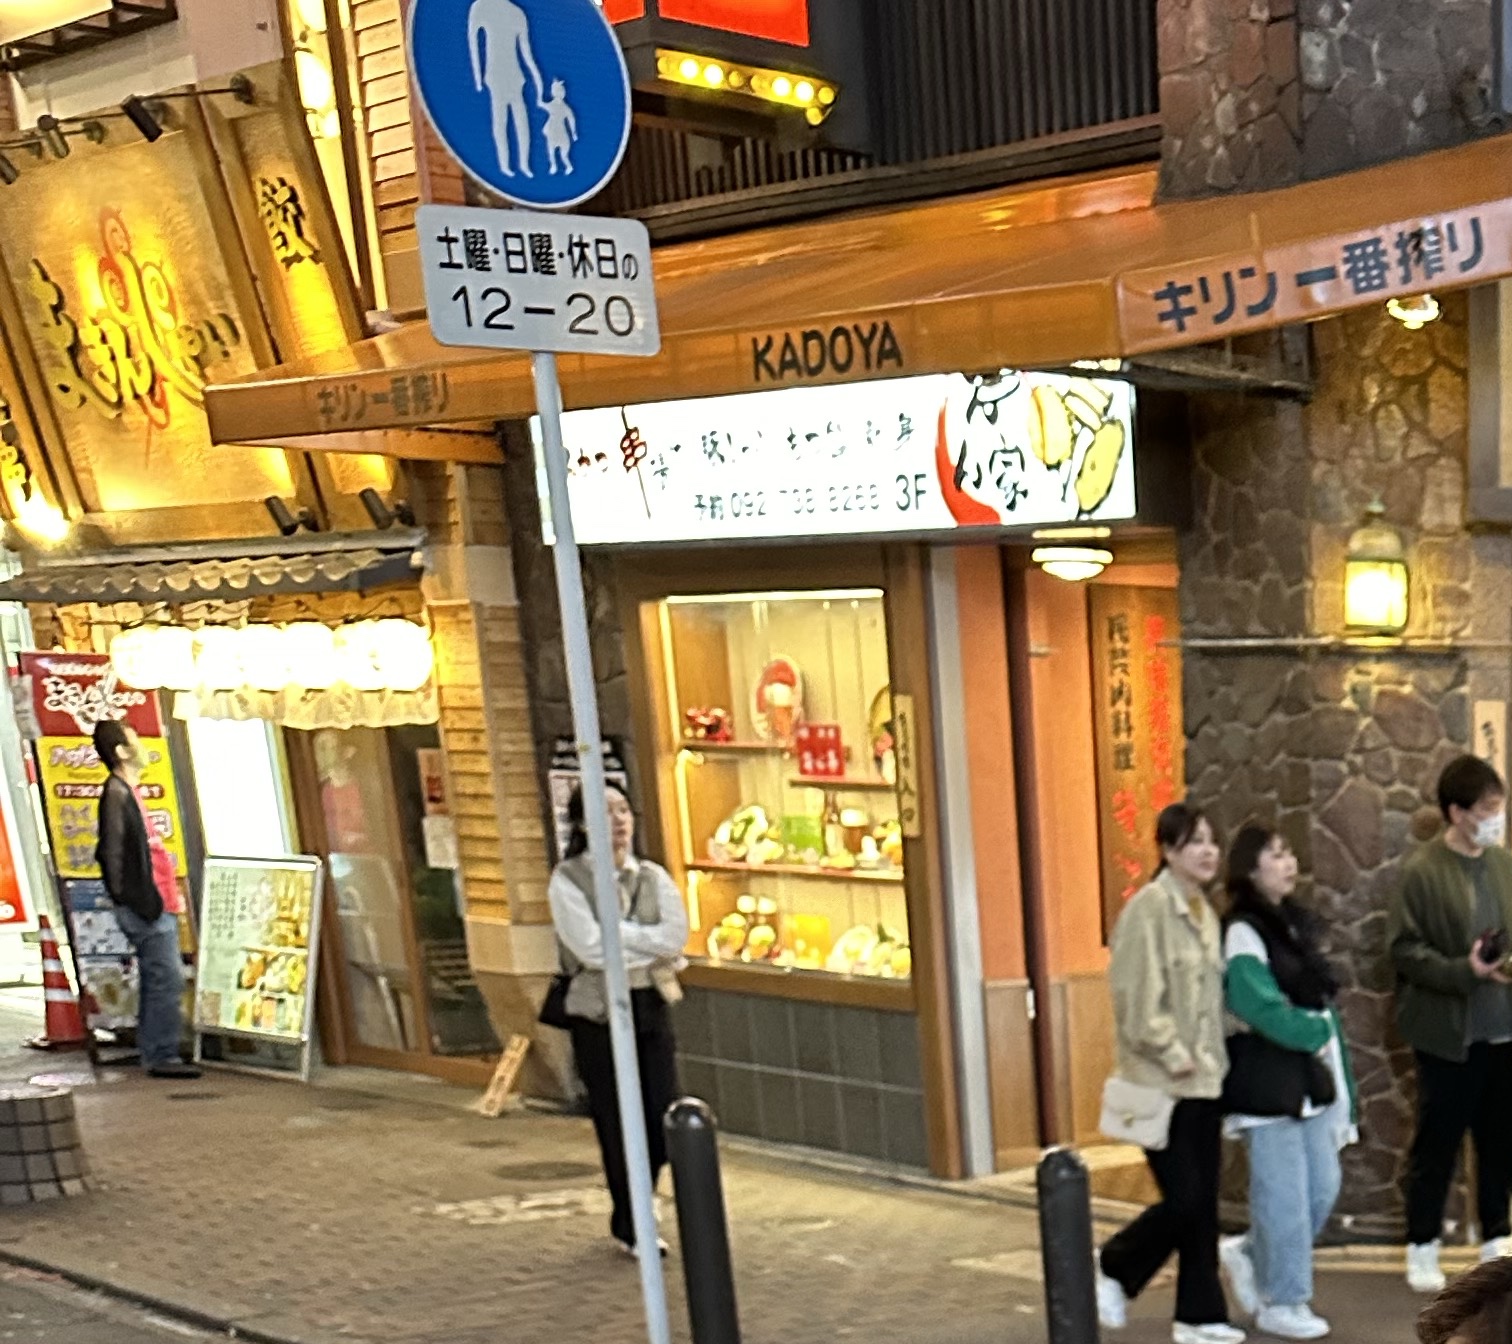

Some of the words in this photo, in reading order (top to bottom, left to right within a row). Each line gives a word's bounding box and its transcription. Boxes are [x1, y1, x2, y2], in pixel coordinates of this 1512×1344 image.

[436, 226, 640, 282] 土曜・日曜・休日の
[1153, 216, 1484, 333] キリン一番搾り
[751, 319, 904, 383] KADOYA
[895, 473, 927, 512] 3F
